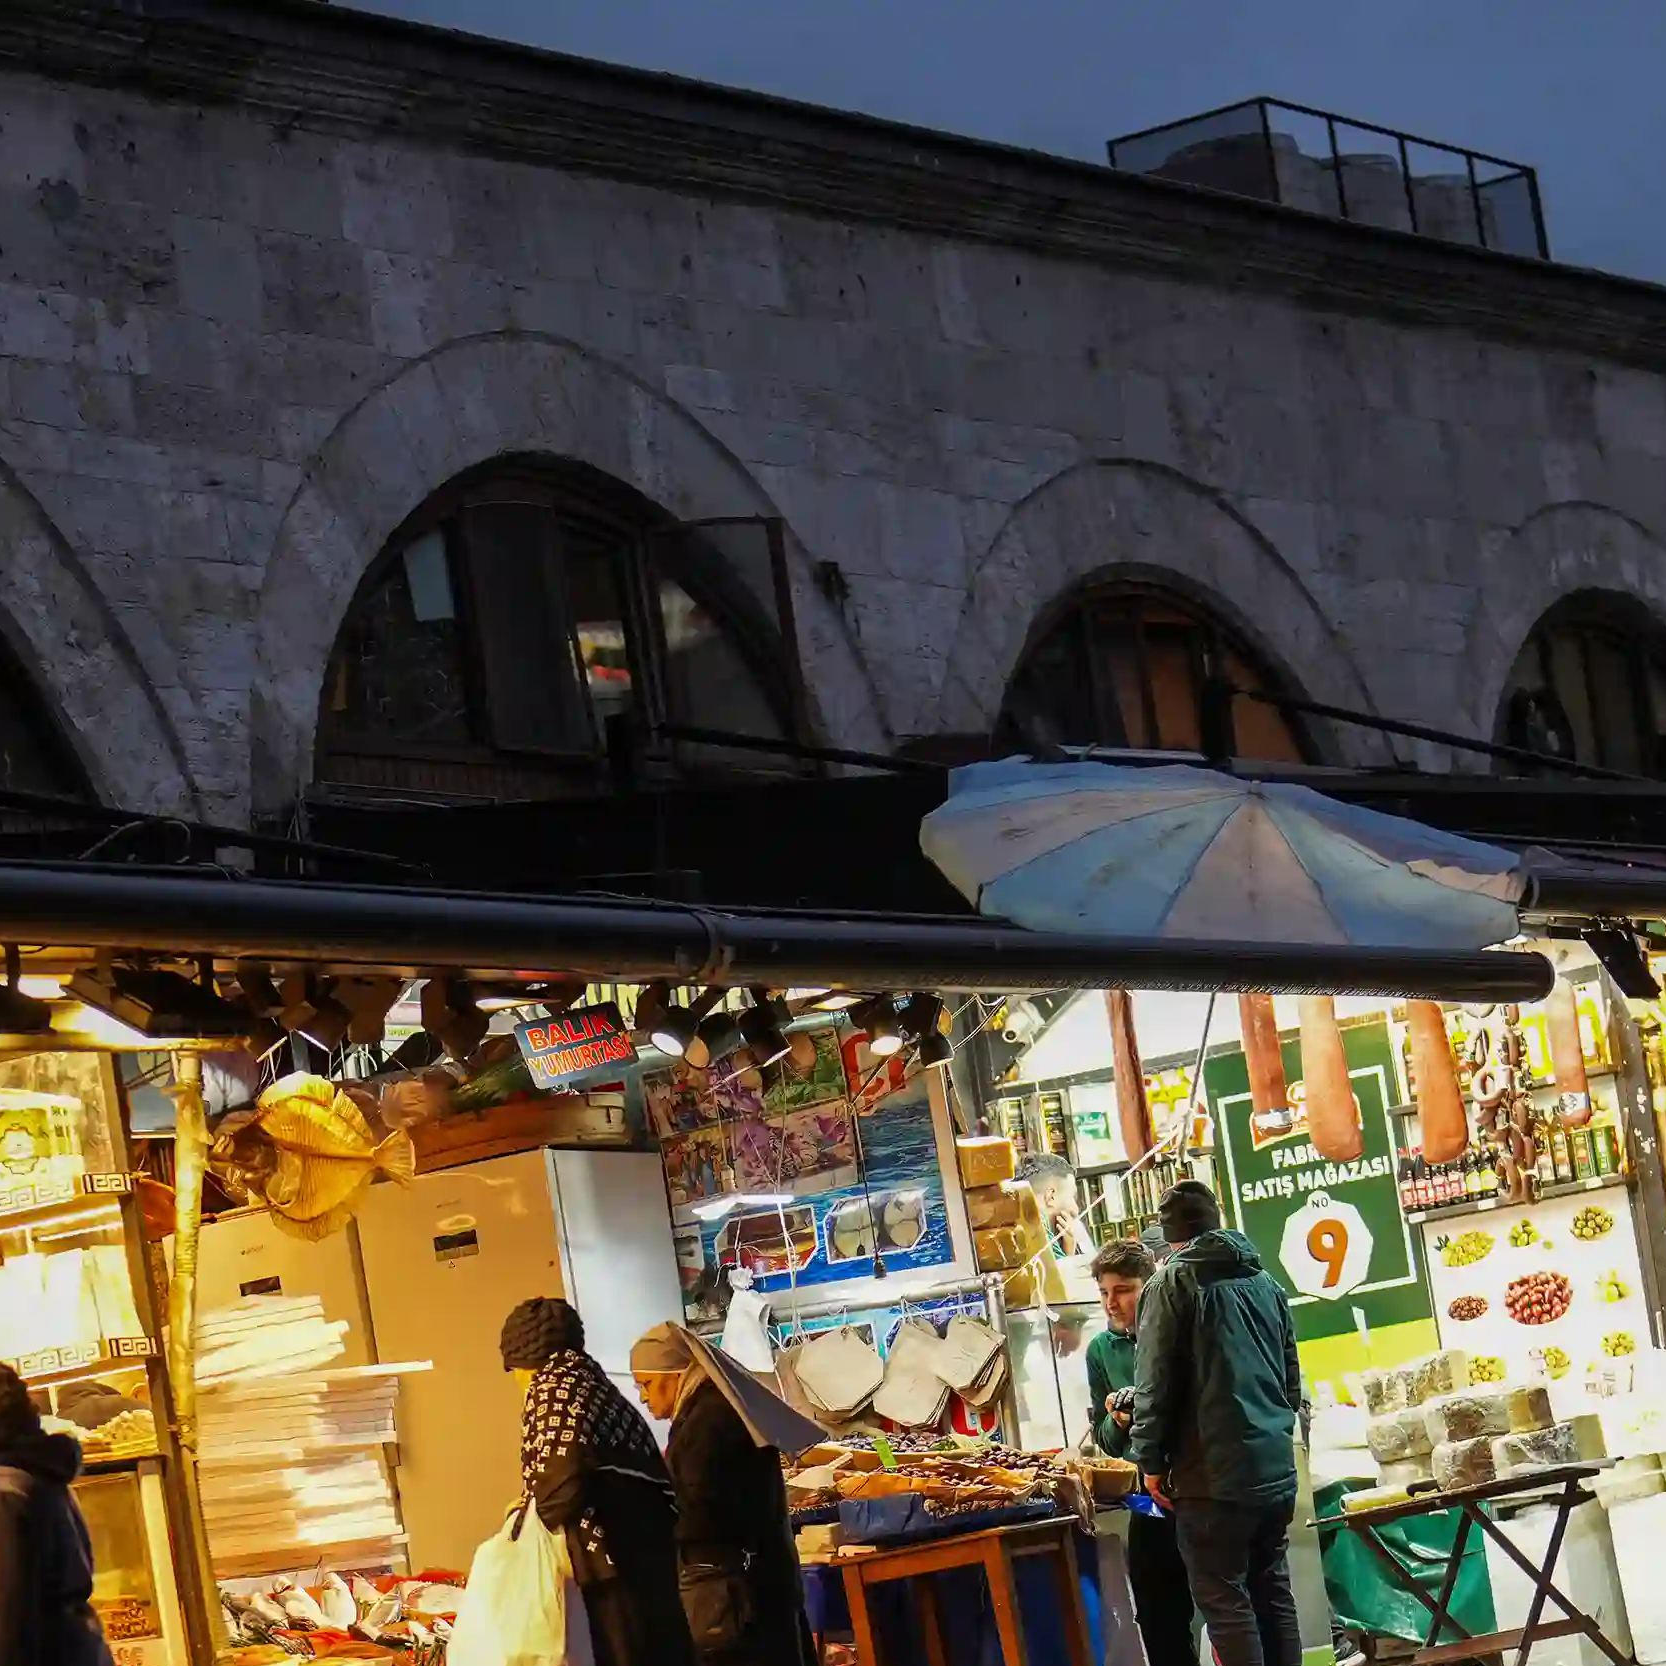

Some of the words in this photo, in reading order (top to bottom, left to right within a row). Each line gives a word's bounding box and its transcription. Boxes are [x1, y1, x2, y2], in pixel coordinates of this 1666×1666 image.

[527, 1012, 617, 1053] BALIK
[1271, 1145, 1326, 1170] FABR
[1241, 1174, 1296, 1203] SATIŞ
[1297, 1155, 1393, 1192] MAĞAZASI
[1310, 1195, 1330, 1209] NO
[1306, 1218, 1349, 1289] 9
